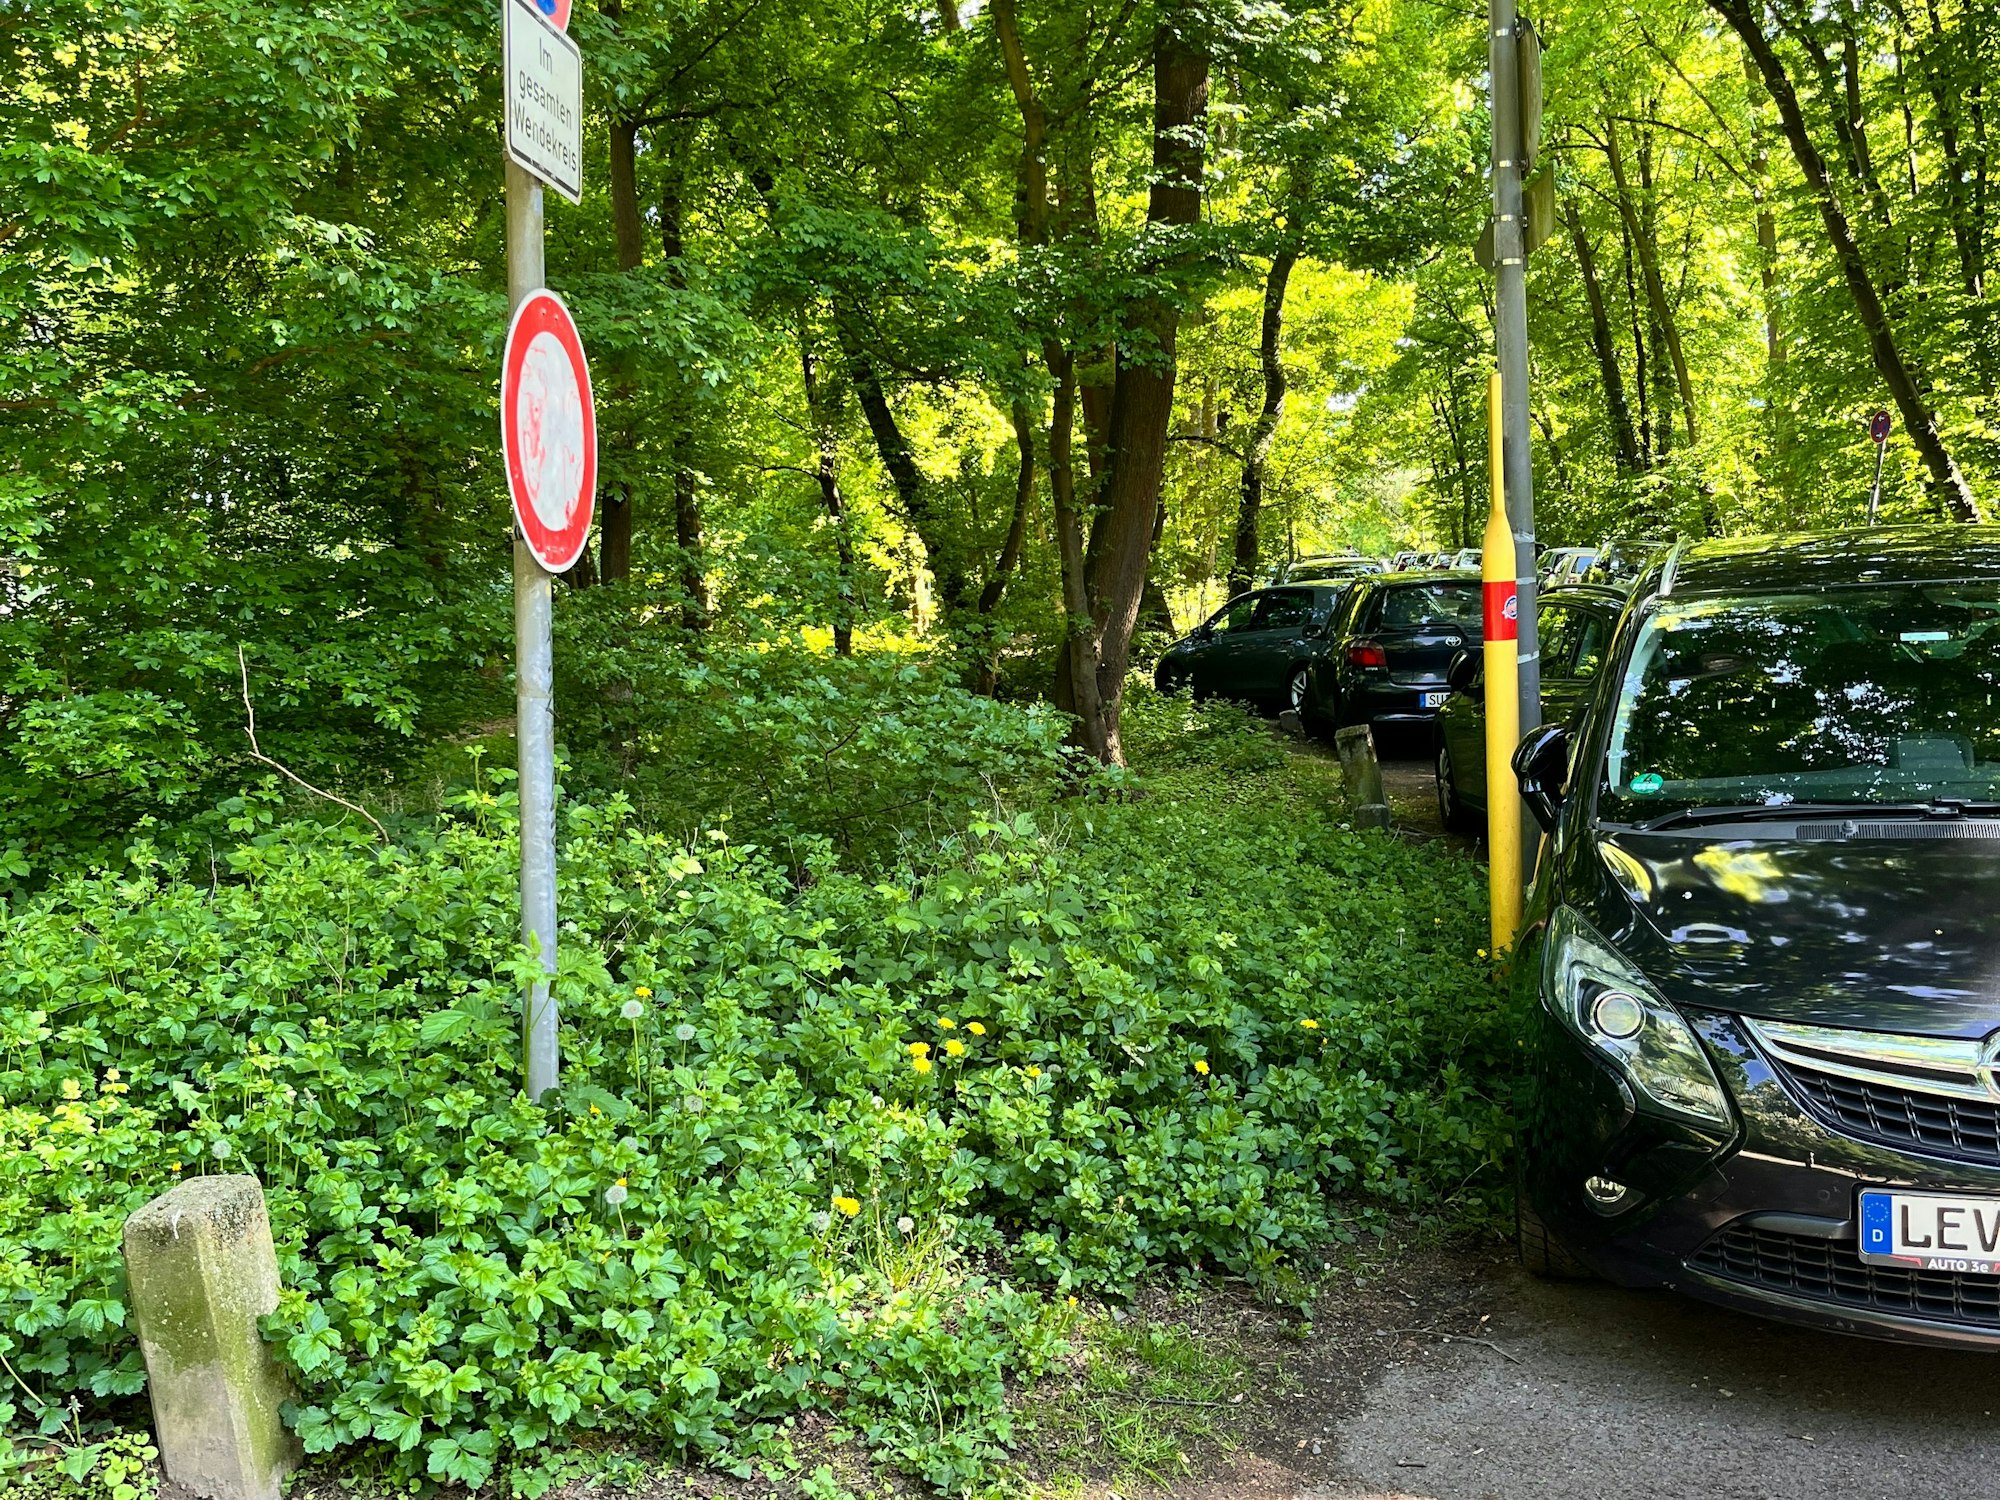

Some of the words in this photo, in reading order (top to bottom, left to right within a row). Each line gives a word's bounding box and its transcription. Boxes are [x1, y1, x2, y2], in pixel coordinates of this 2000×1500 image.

[539, 37, 553, 75] Im
[519, 69, 572, 130] gesamten
[514, 99, 577, 172] Wendekreis
[1872, 1229, 1883, 1242] D
[1927, 1258, 1967, 1271] AUTO
